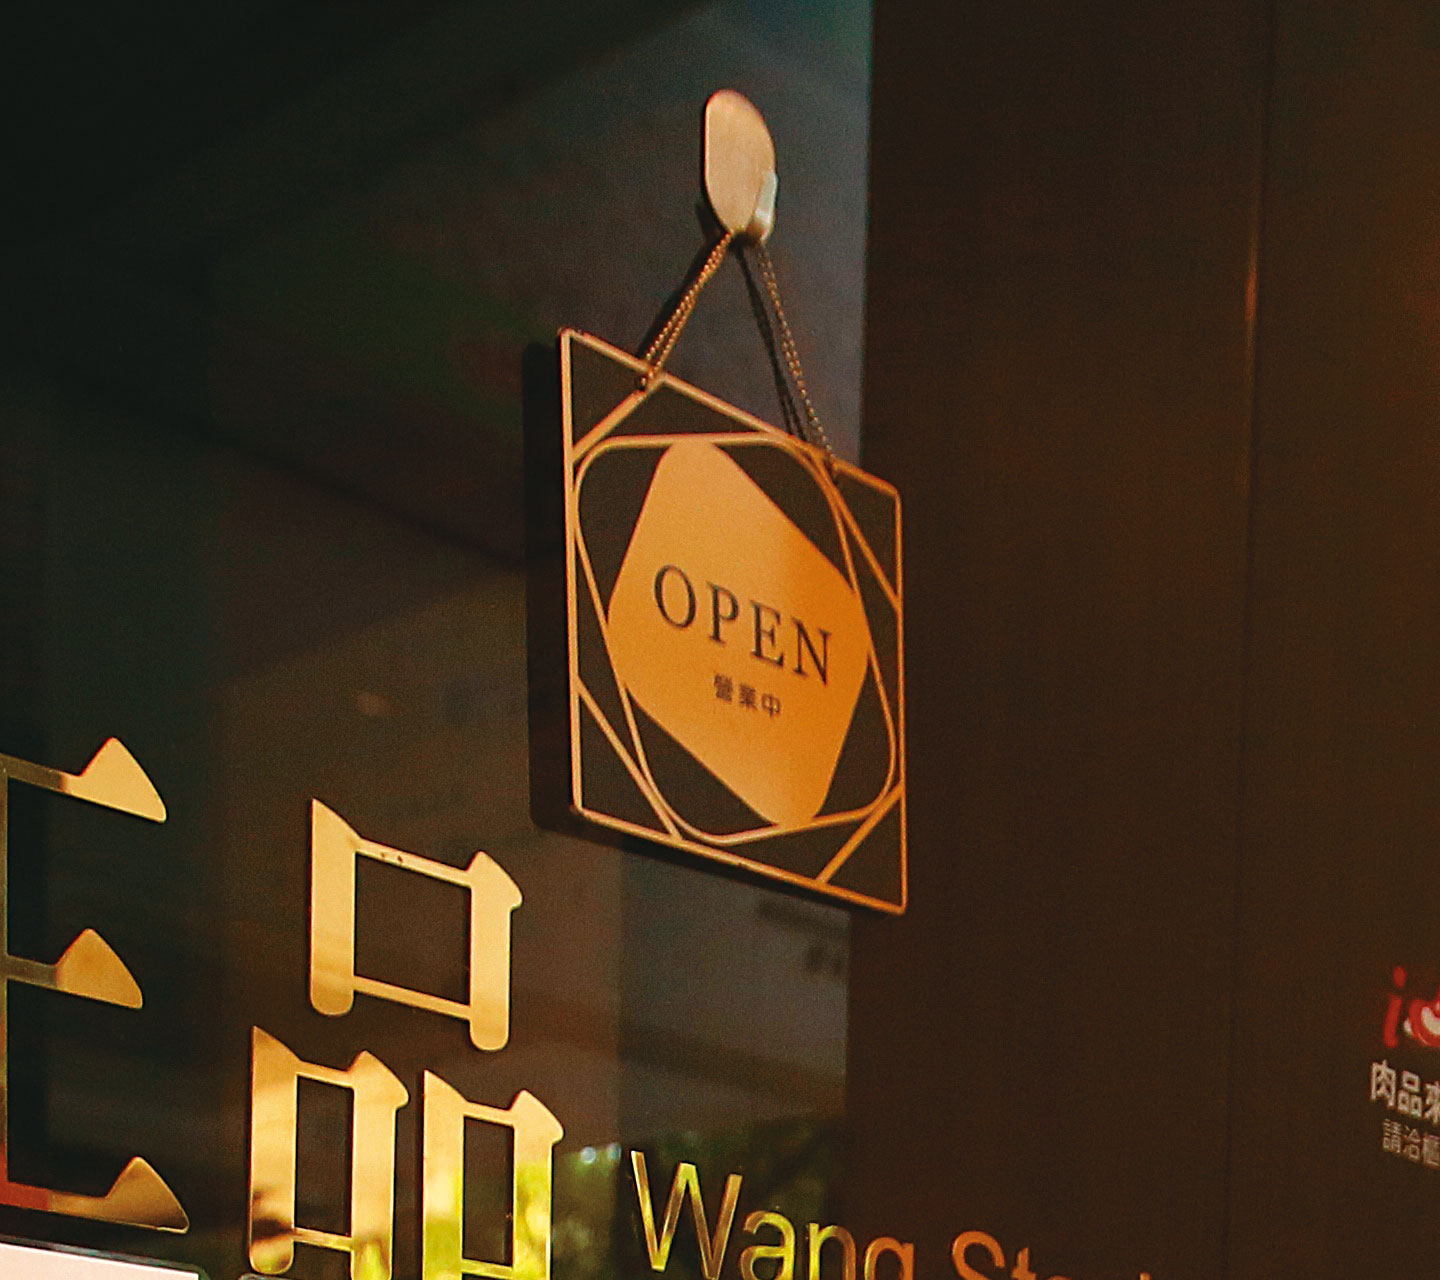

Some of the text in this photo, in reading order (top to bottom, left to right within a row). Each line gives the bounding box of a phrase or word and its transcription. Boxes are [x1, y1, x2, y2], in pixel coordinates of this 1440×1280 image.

[653, 564, 832, 686] OPEN
[713, 674, 781, 719] 營業中
